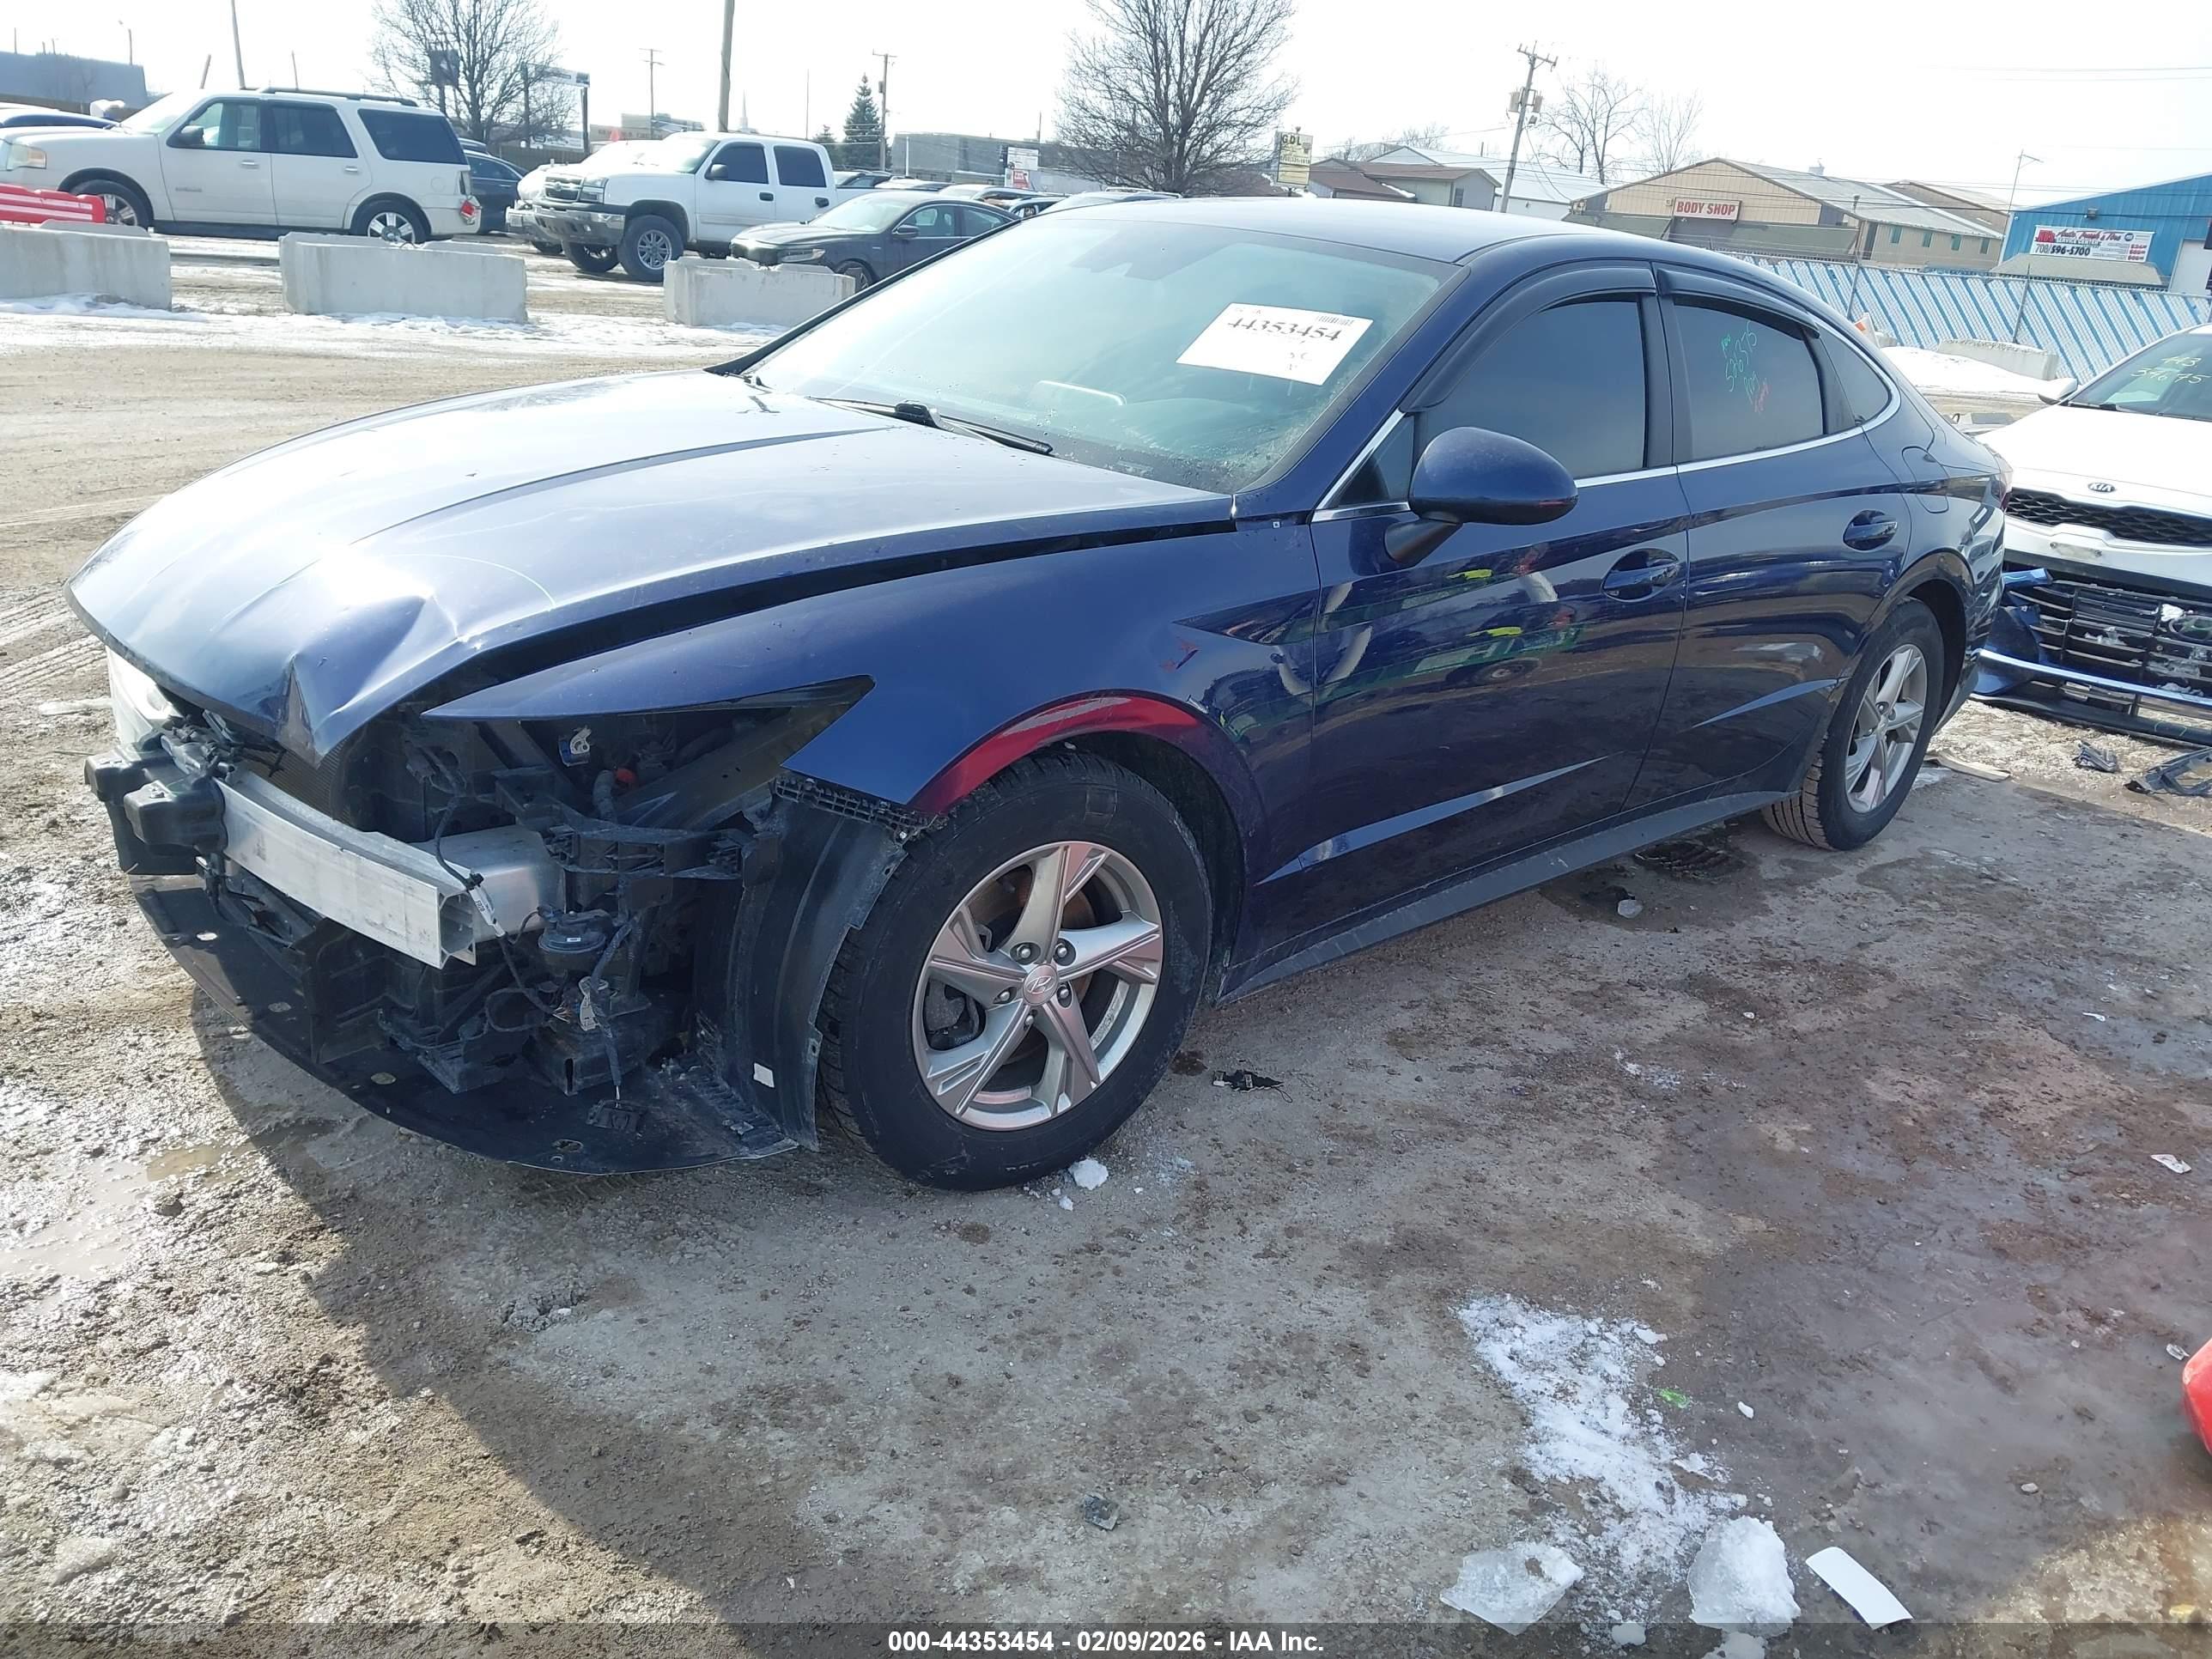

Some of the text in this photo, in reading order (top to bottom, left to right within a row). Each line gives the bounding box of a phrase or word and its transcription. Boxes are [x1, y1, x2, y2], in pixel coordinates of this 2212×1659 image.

[1282, 134, 1302, 146] GDL
[1676, 201, 1735, 216] BODY SHOP
[1227, 318, 1343, 341] 44353454
[2089, 483, 2112, 492] KIA
